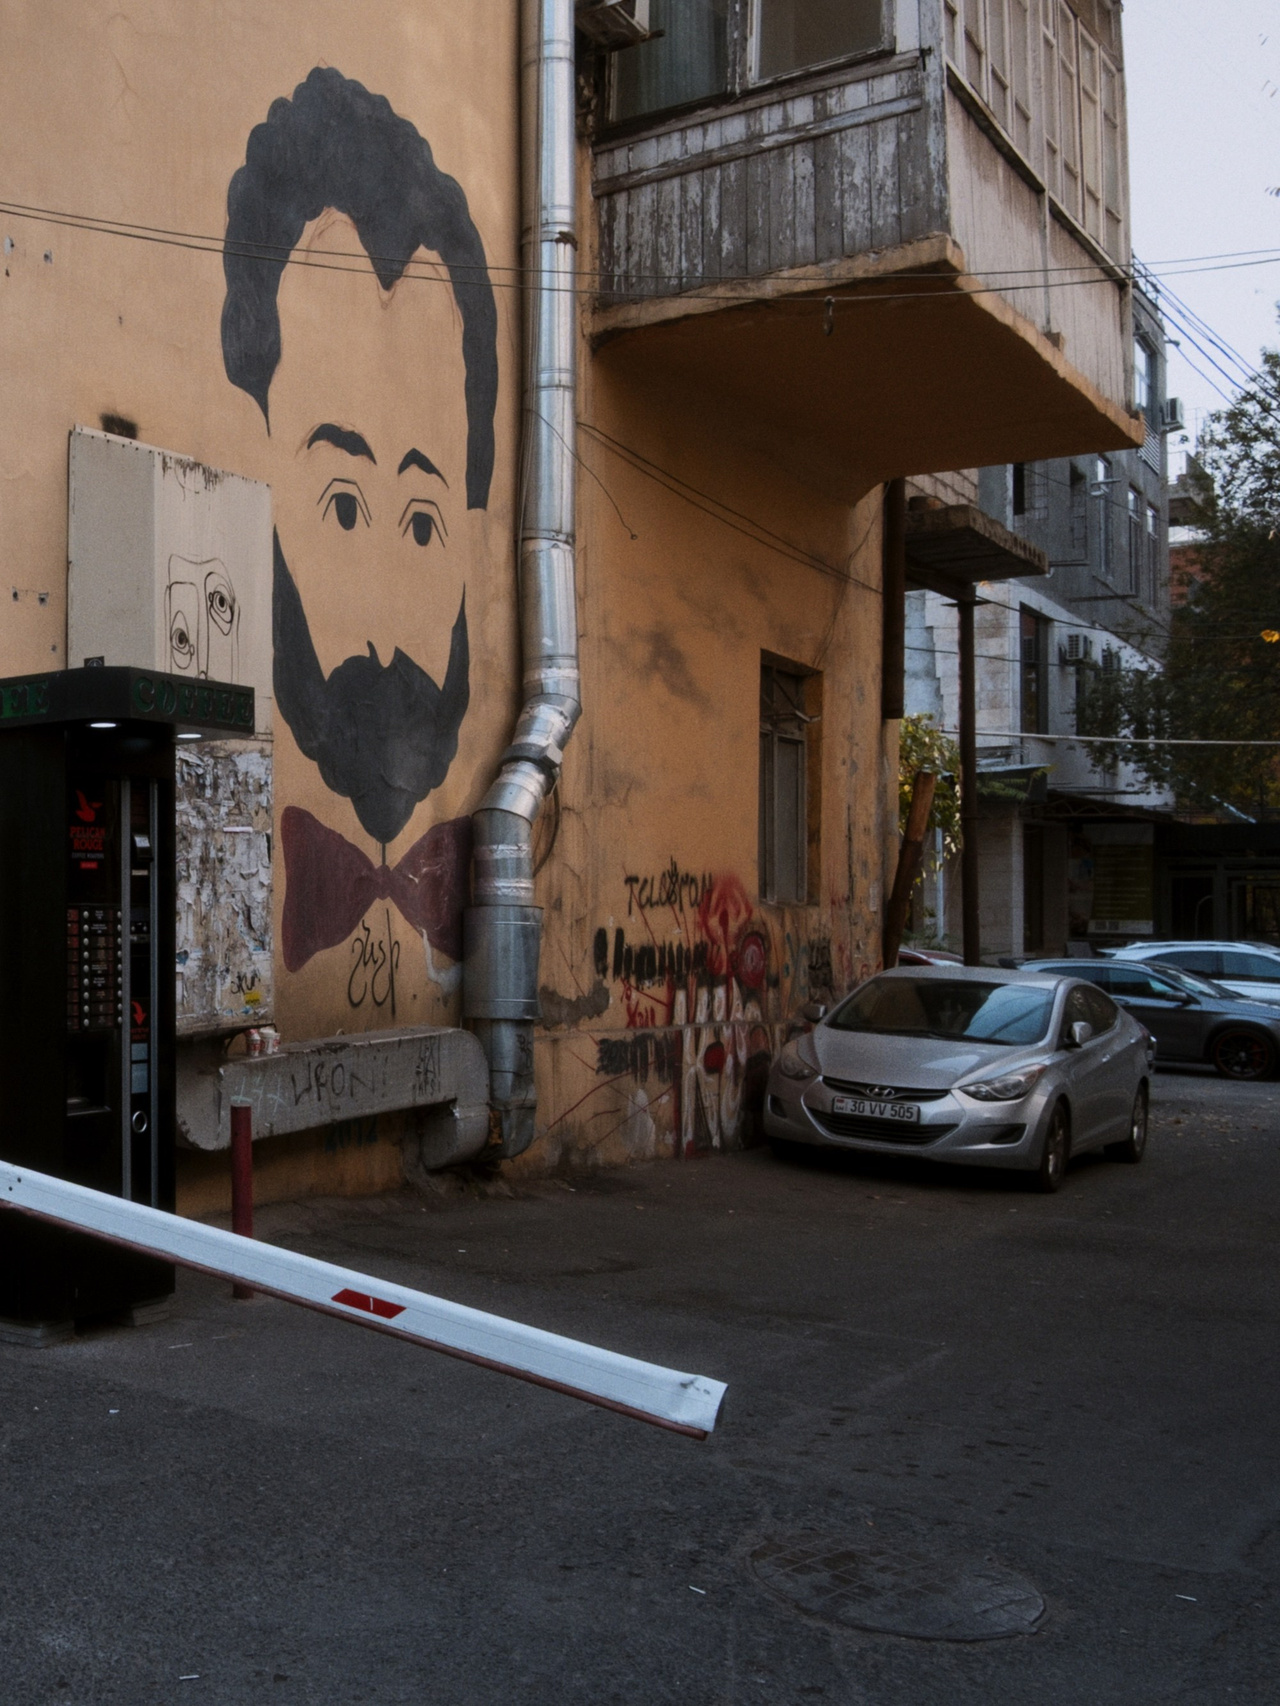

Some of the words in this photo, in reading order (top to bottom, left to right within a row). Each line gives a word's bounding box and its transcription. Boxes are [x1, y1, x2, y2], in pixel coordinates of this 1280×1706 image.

[132, 676, 254, 726] COFFEE
[73, 839, 104, 851] ROUGE
[850, 1100, 865, 1114] 30
[869, 1102, 887, 1116] VV
[890, 1104, 914, 1120] 505
